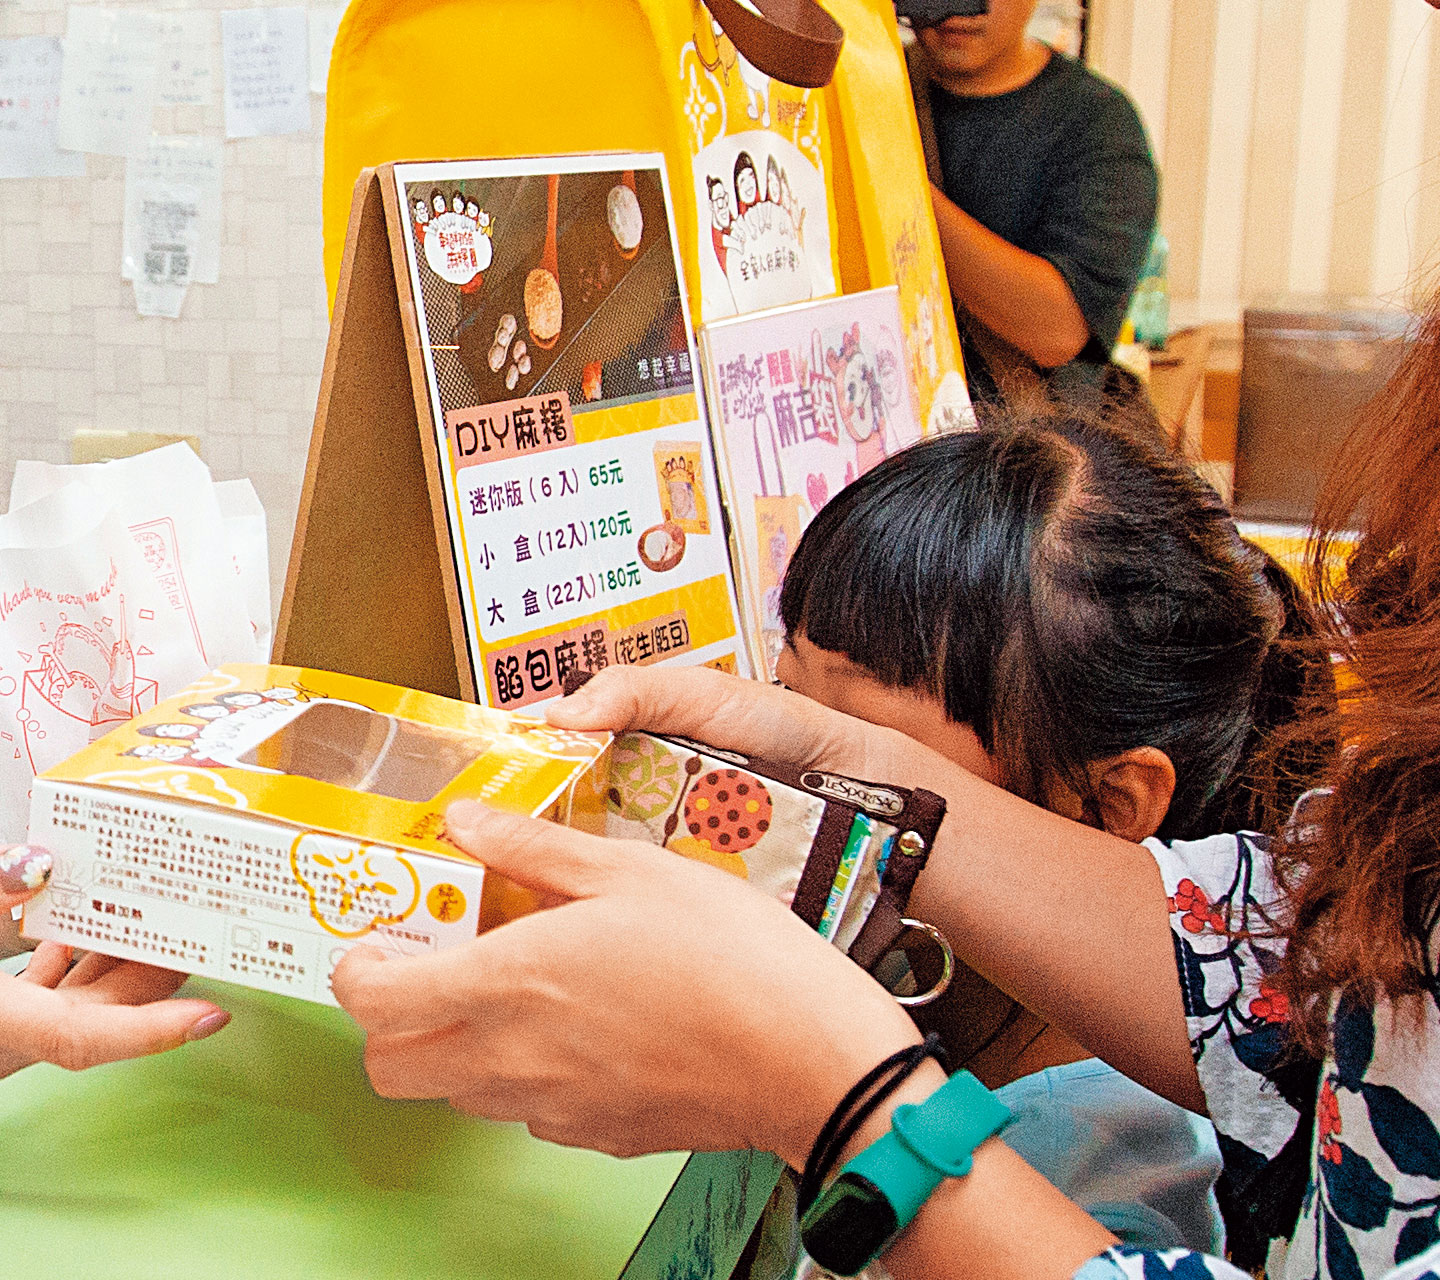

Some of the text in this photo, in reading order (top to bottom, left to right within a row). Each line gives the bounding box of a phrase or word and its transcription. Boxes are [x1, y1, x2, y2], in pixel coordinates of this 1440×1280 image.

[589, 459, 624, 486] 65元
[589, 510, 633, 541] 120元
[599, 561, 641, 592] 180元
